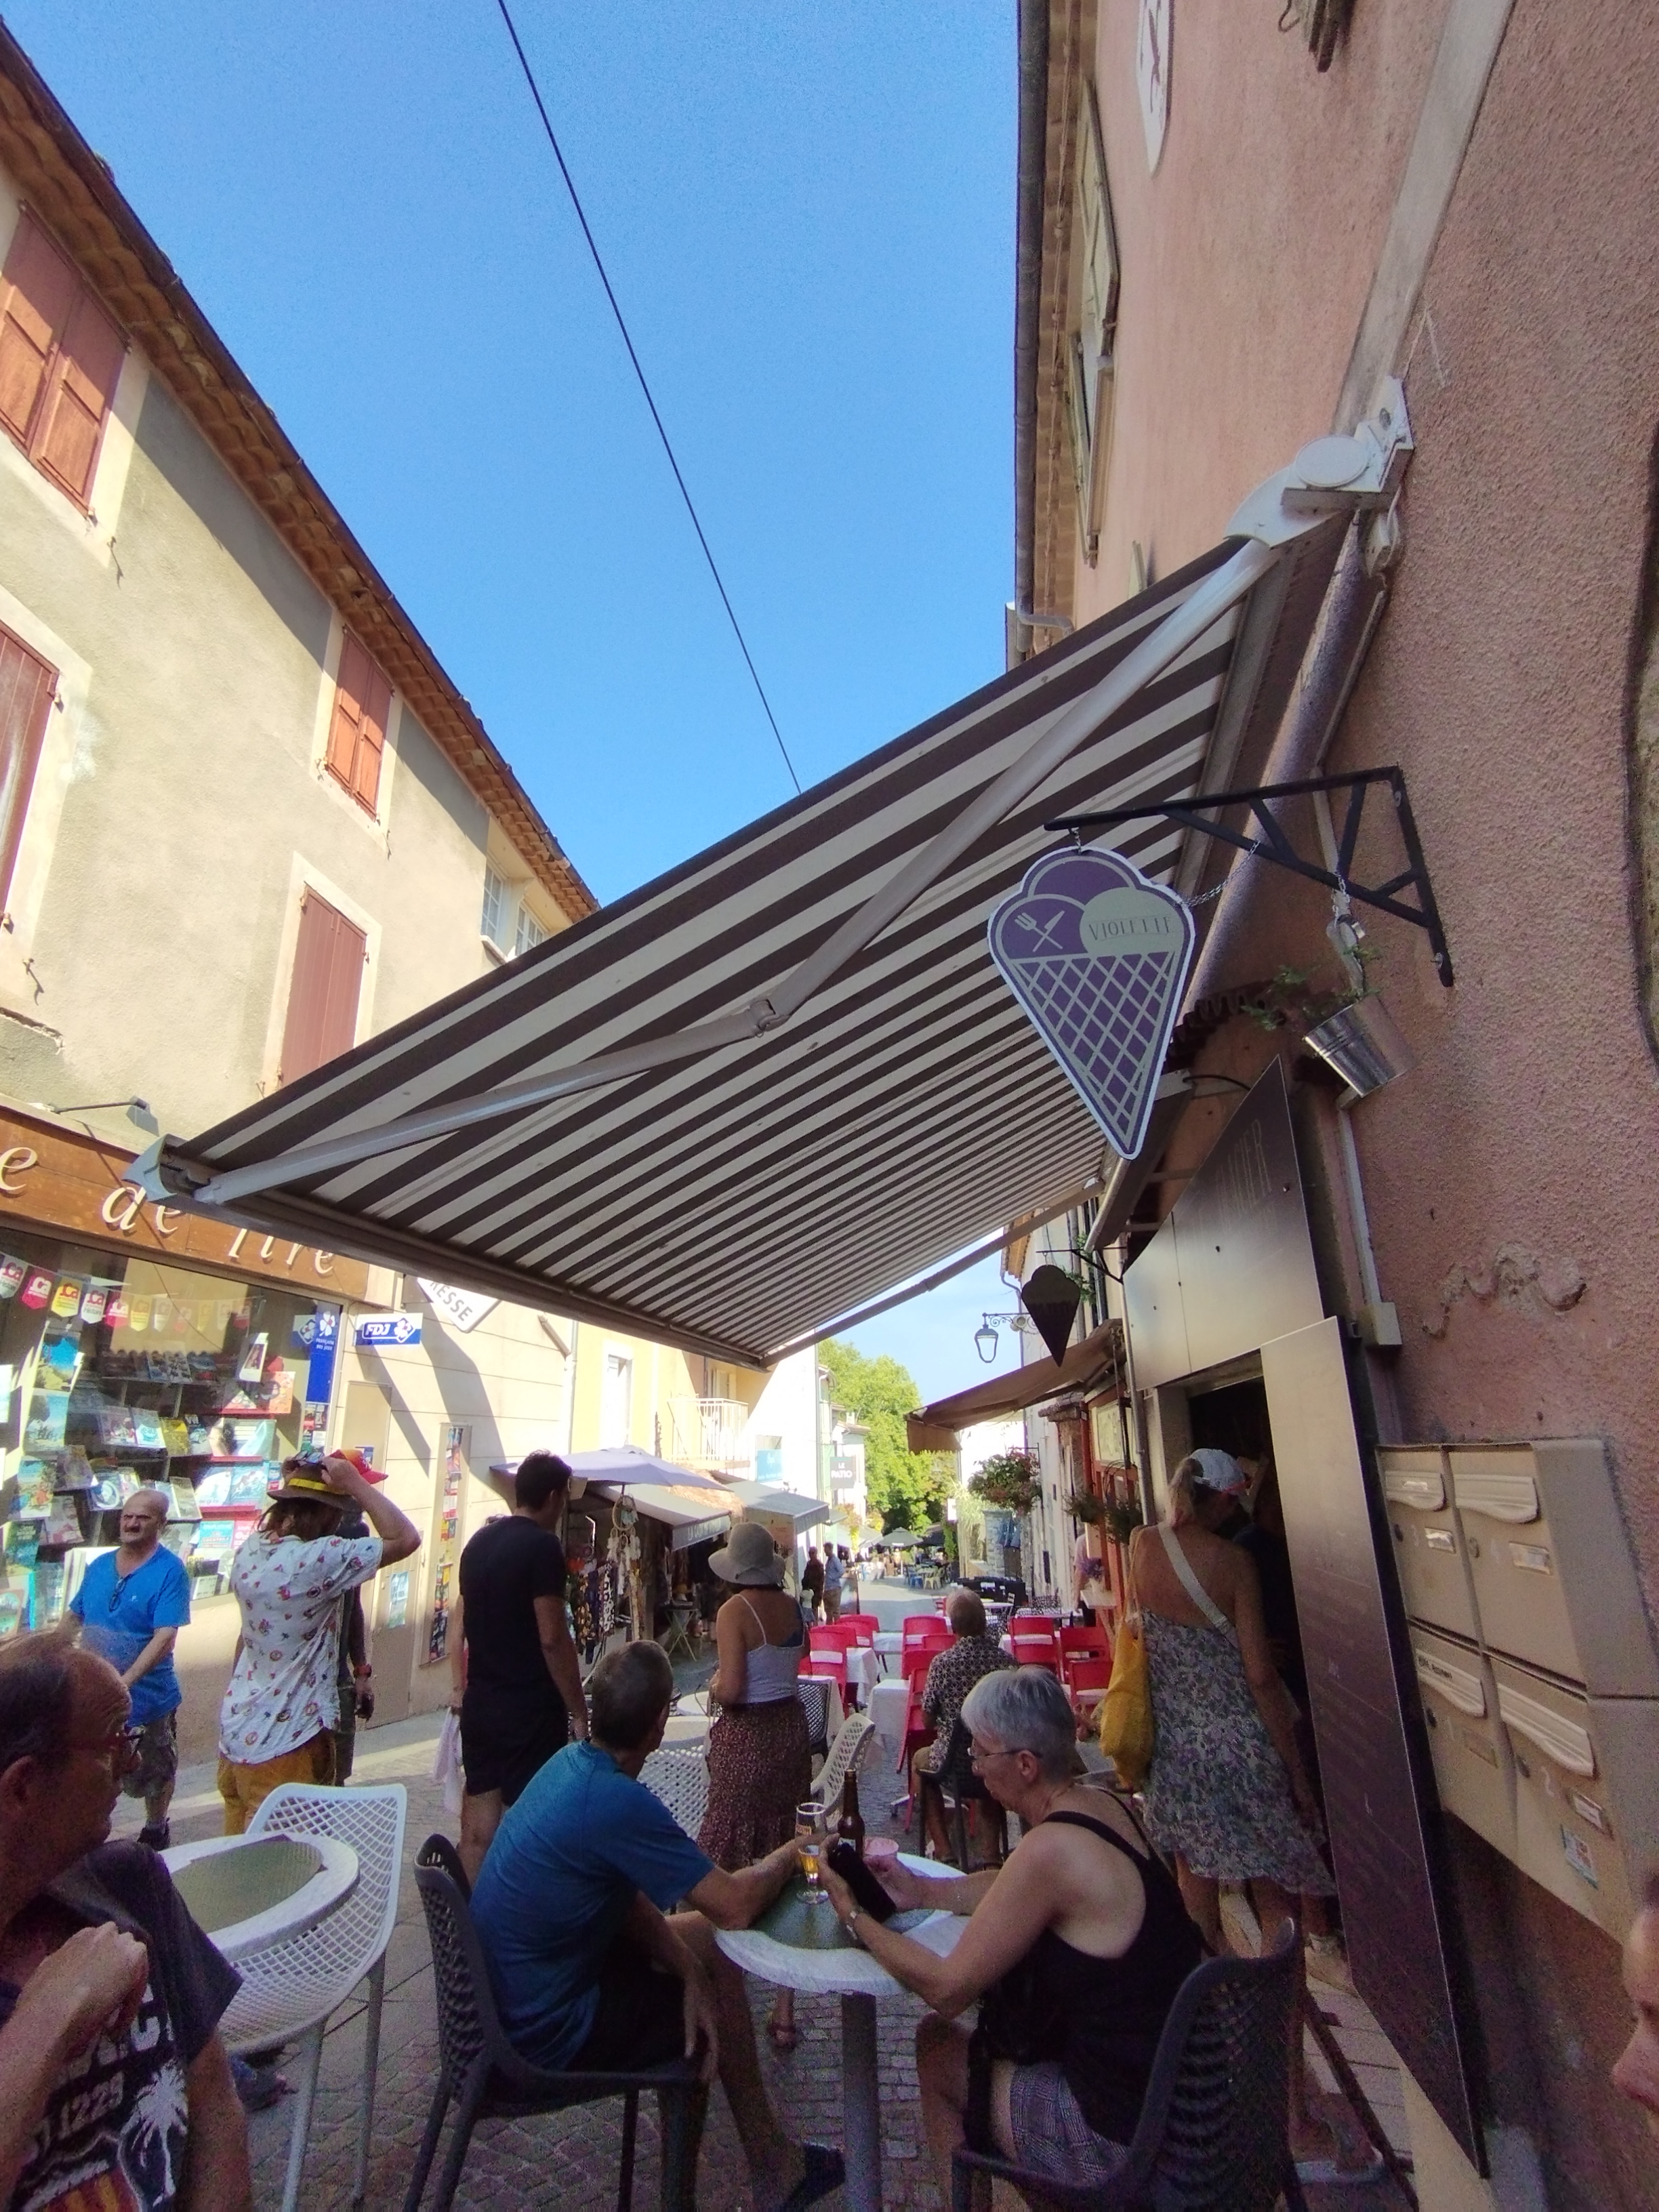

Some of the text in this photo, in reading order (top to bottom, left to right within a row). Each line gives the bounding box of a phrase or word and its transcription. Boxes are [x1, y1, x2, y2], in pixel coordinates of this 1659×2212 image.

[429, 1280, 473, 1322] RESSE
[365, 1324, 391, 1336] FDJ
[831, 1470, 853, 1478] PATIO
